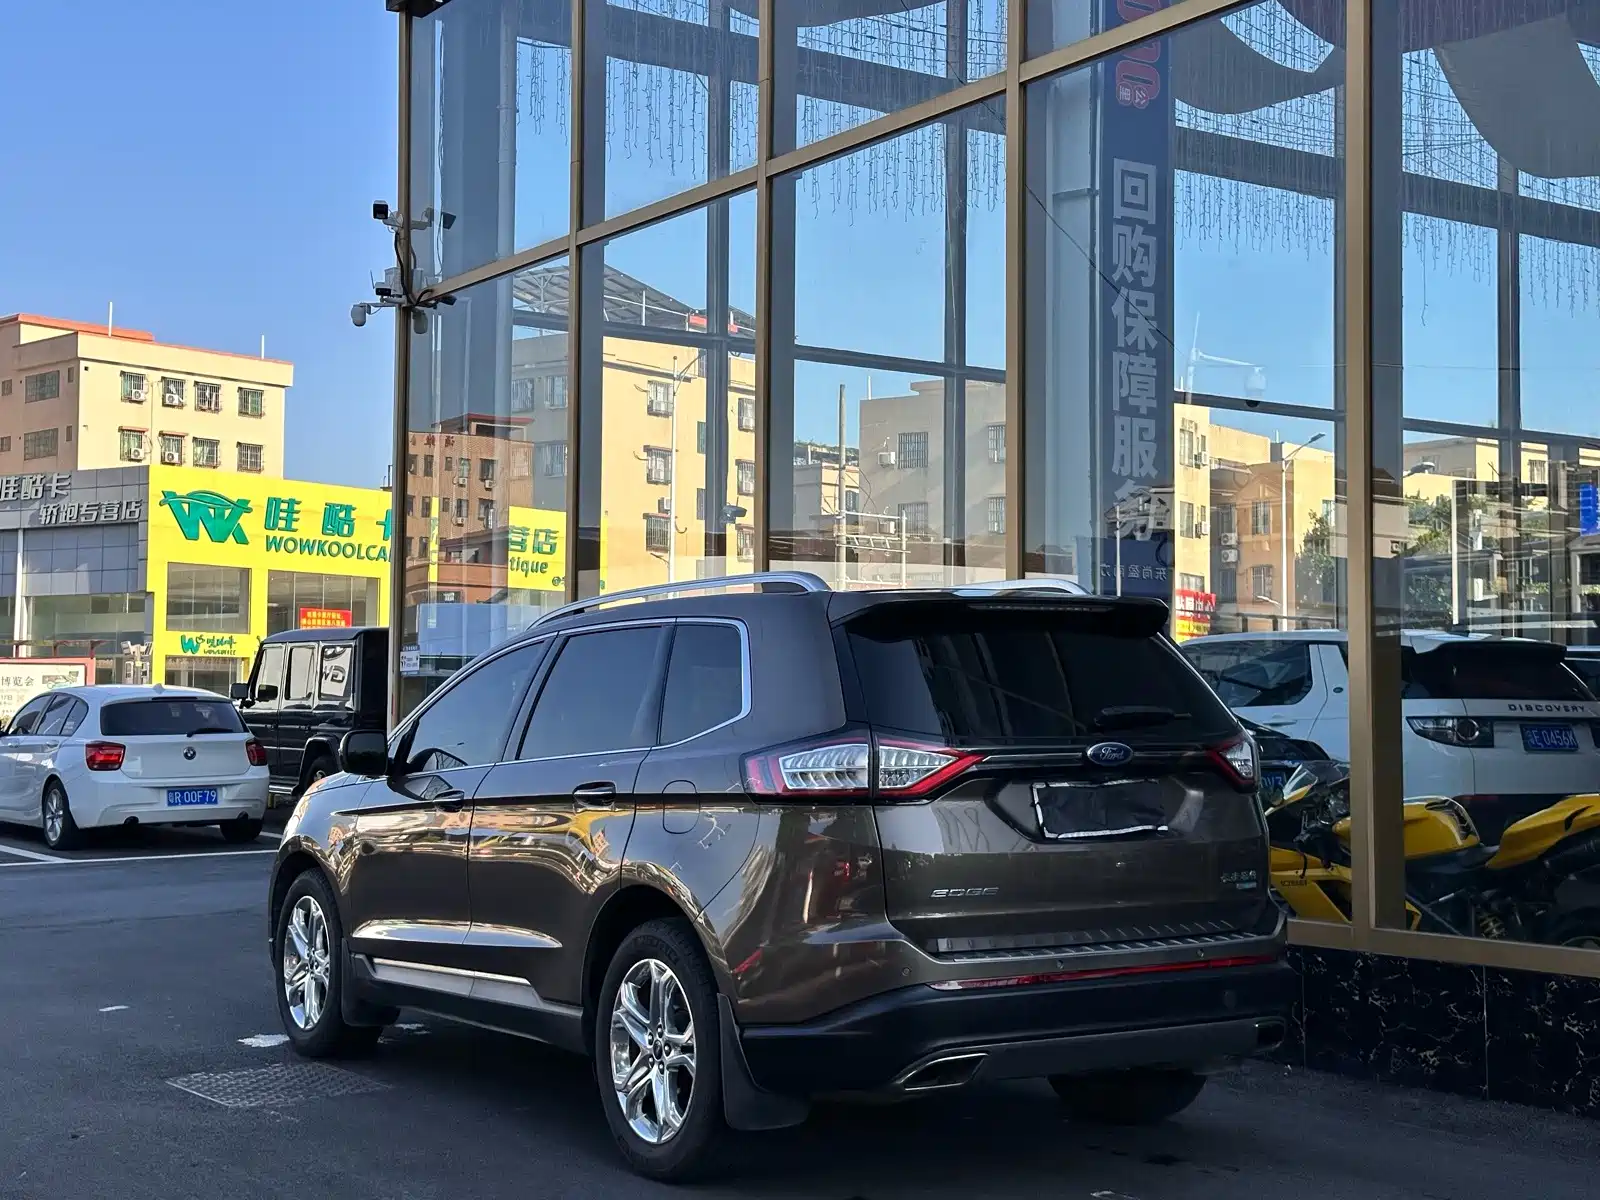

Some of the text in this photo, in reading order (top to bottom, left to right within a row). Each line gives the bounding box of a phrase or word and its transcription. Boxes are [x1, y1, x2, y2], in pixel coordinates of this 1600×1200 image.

[1112, 157, 1158, 541] 回购保障服务
[39, 499, 142, 525] 轿跑专营店
[265, 535, 391, 562] WOWKOOLCA
[1508, 703, 1585, 713] DISCOVERY
[1100, 747, 1125, 760] Ford
[930, 887, 999, 898] EDGE
